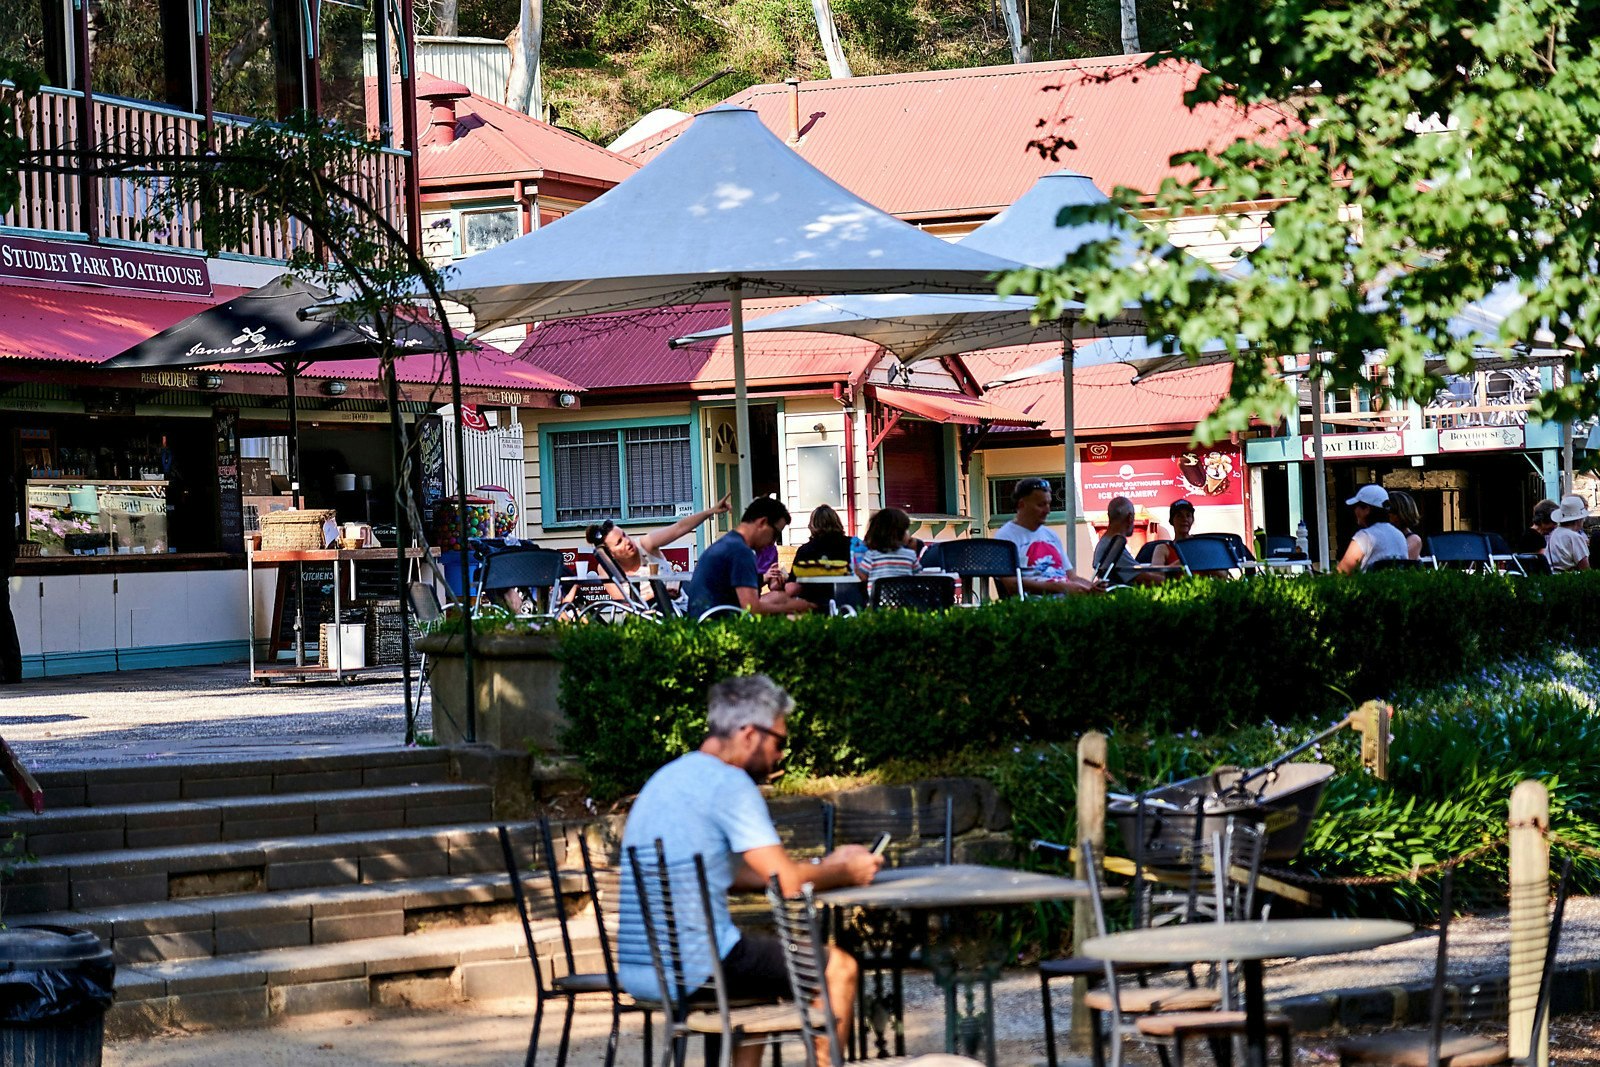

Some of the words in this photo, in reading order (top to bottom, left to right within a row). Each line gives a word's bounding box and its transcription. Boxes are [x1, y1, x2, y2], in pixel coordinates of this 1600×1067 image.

[2, 244, 69, 273] STUDLEY
[70, 252, 111, 277] PARK
[111, 256, 204, 286] BOATHOUSE
[185, 341, 241, 356] James
[244, 338, 297, 354] Squire
[141, 372, 158, 384] PLEASE
[158, 371, 189, 388] ORDER
[500, 391, 521, 404] FOOD
[1450, 431, 1500, 440] BOATHOUSE
[1312, 442, 1344, 452] OAT
[1348, 440, 1379, 451] HIRE
[1125, 480, 1160, 488] BOATHOUSE
[1098, 492, 1113, 500] ICE
[1113, 490, 1158, 499] CREAMERY
[301, 571, 334, 581] KITCHENS
